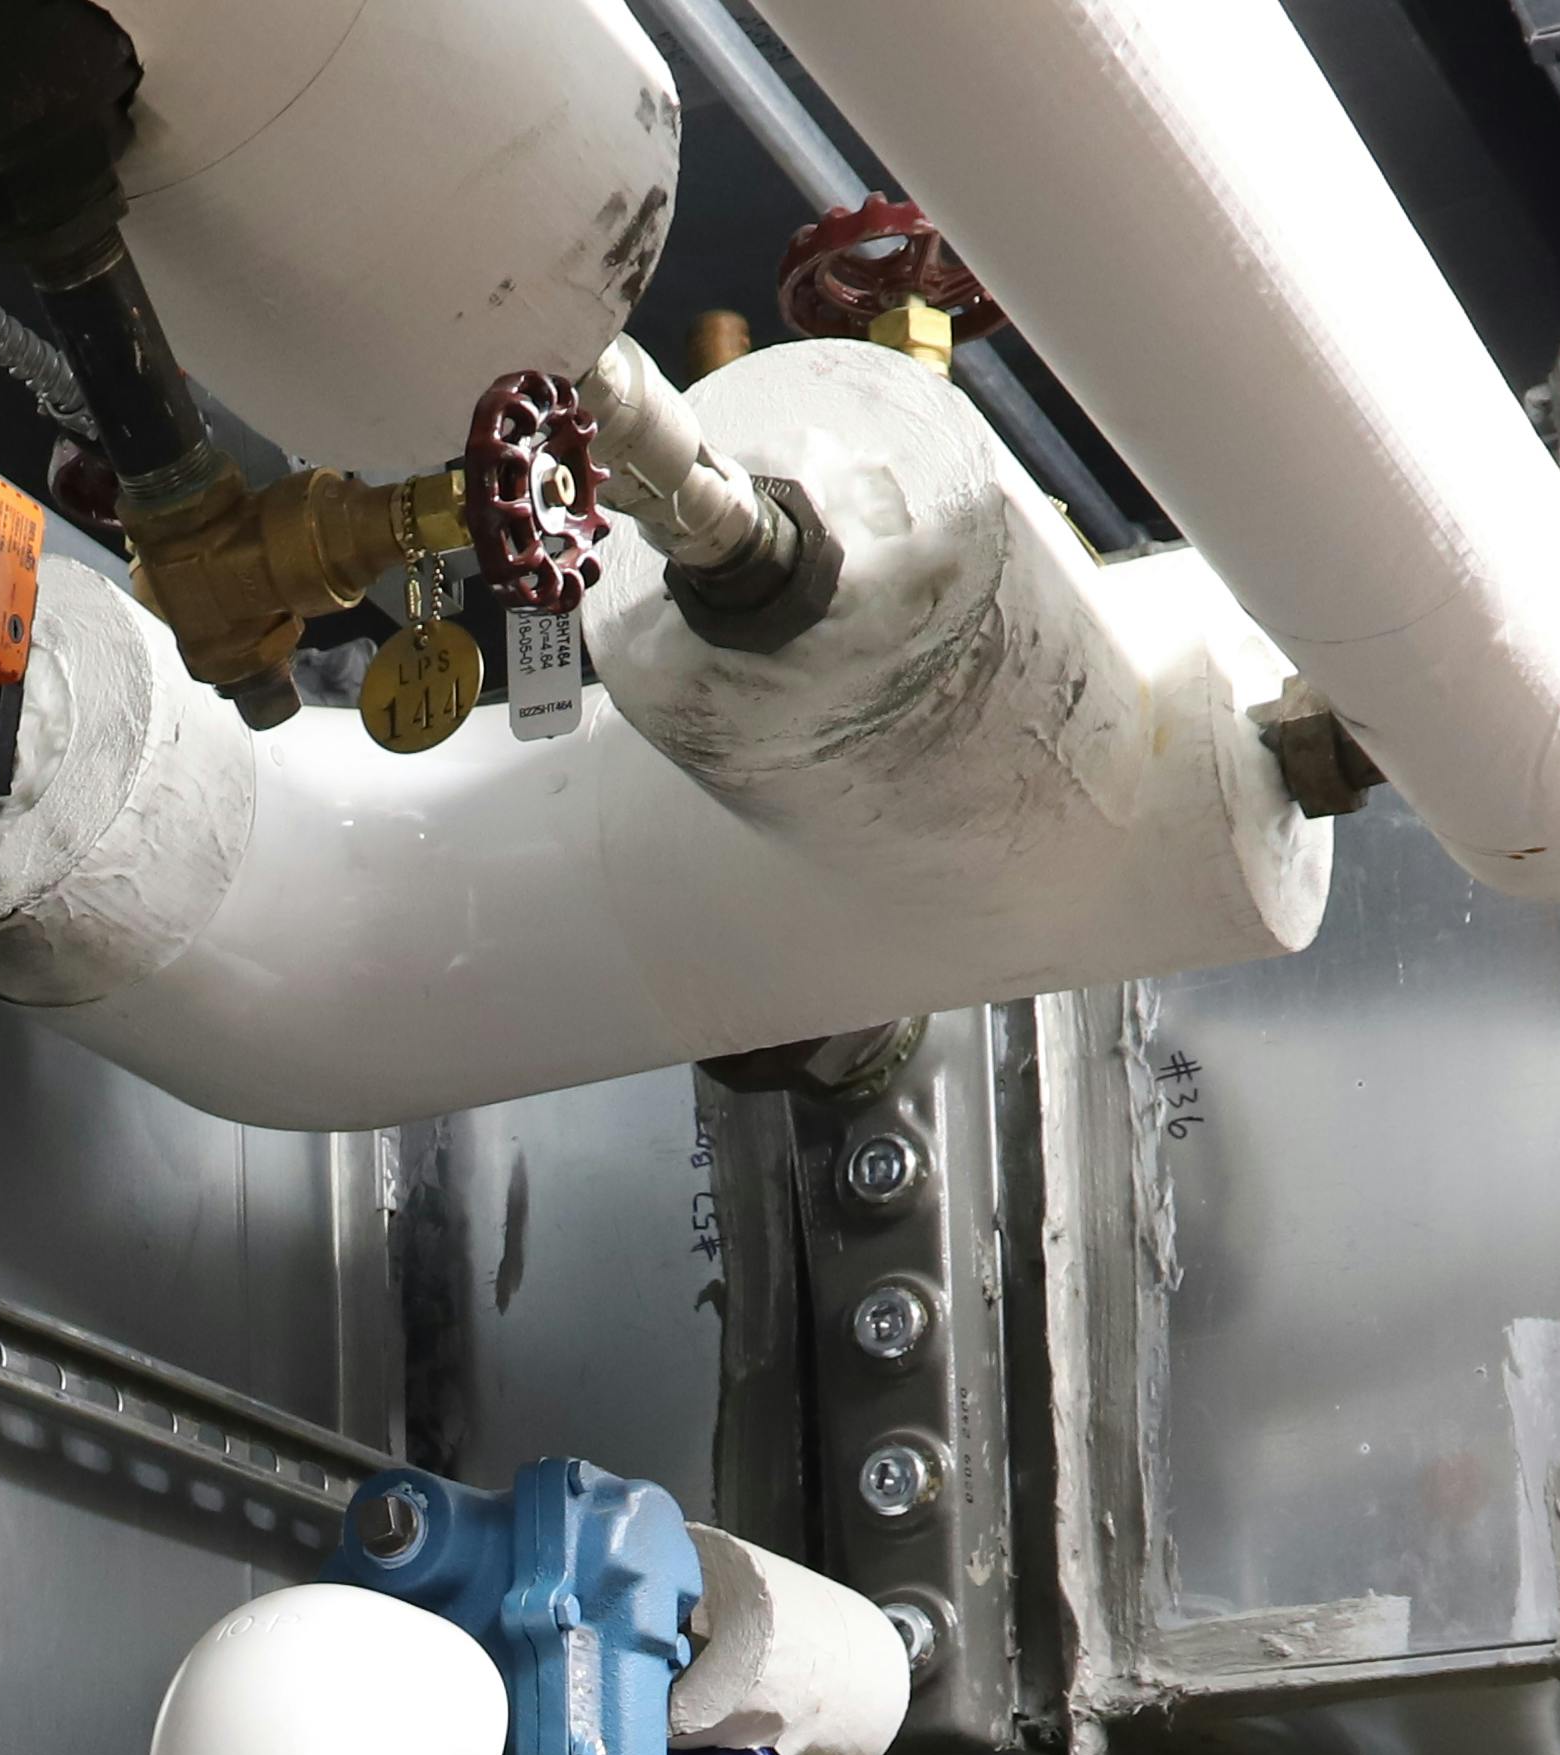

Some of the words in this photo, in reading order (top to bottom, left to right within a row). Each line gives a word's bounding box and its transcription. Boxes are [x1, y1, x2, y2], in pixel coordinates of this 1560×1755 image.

[398, 650, 450, 685] LPS
[378, 677, 464, 741] 144
[1155, 1050, 1205, 1140] #36
